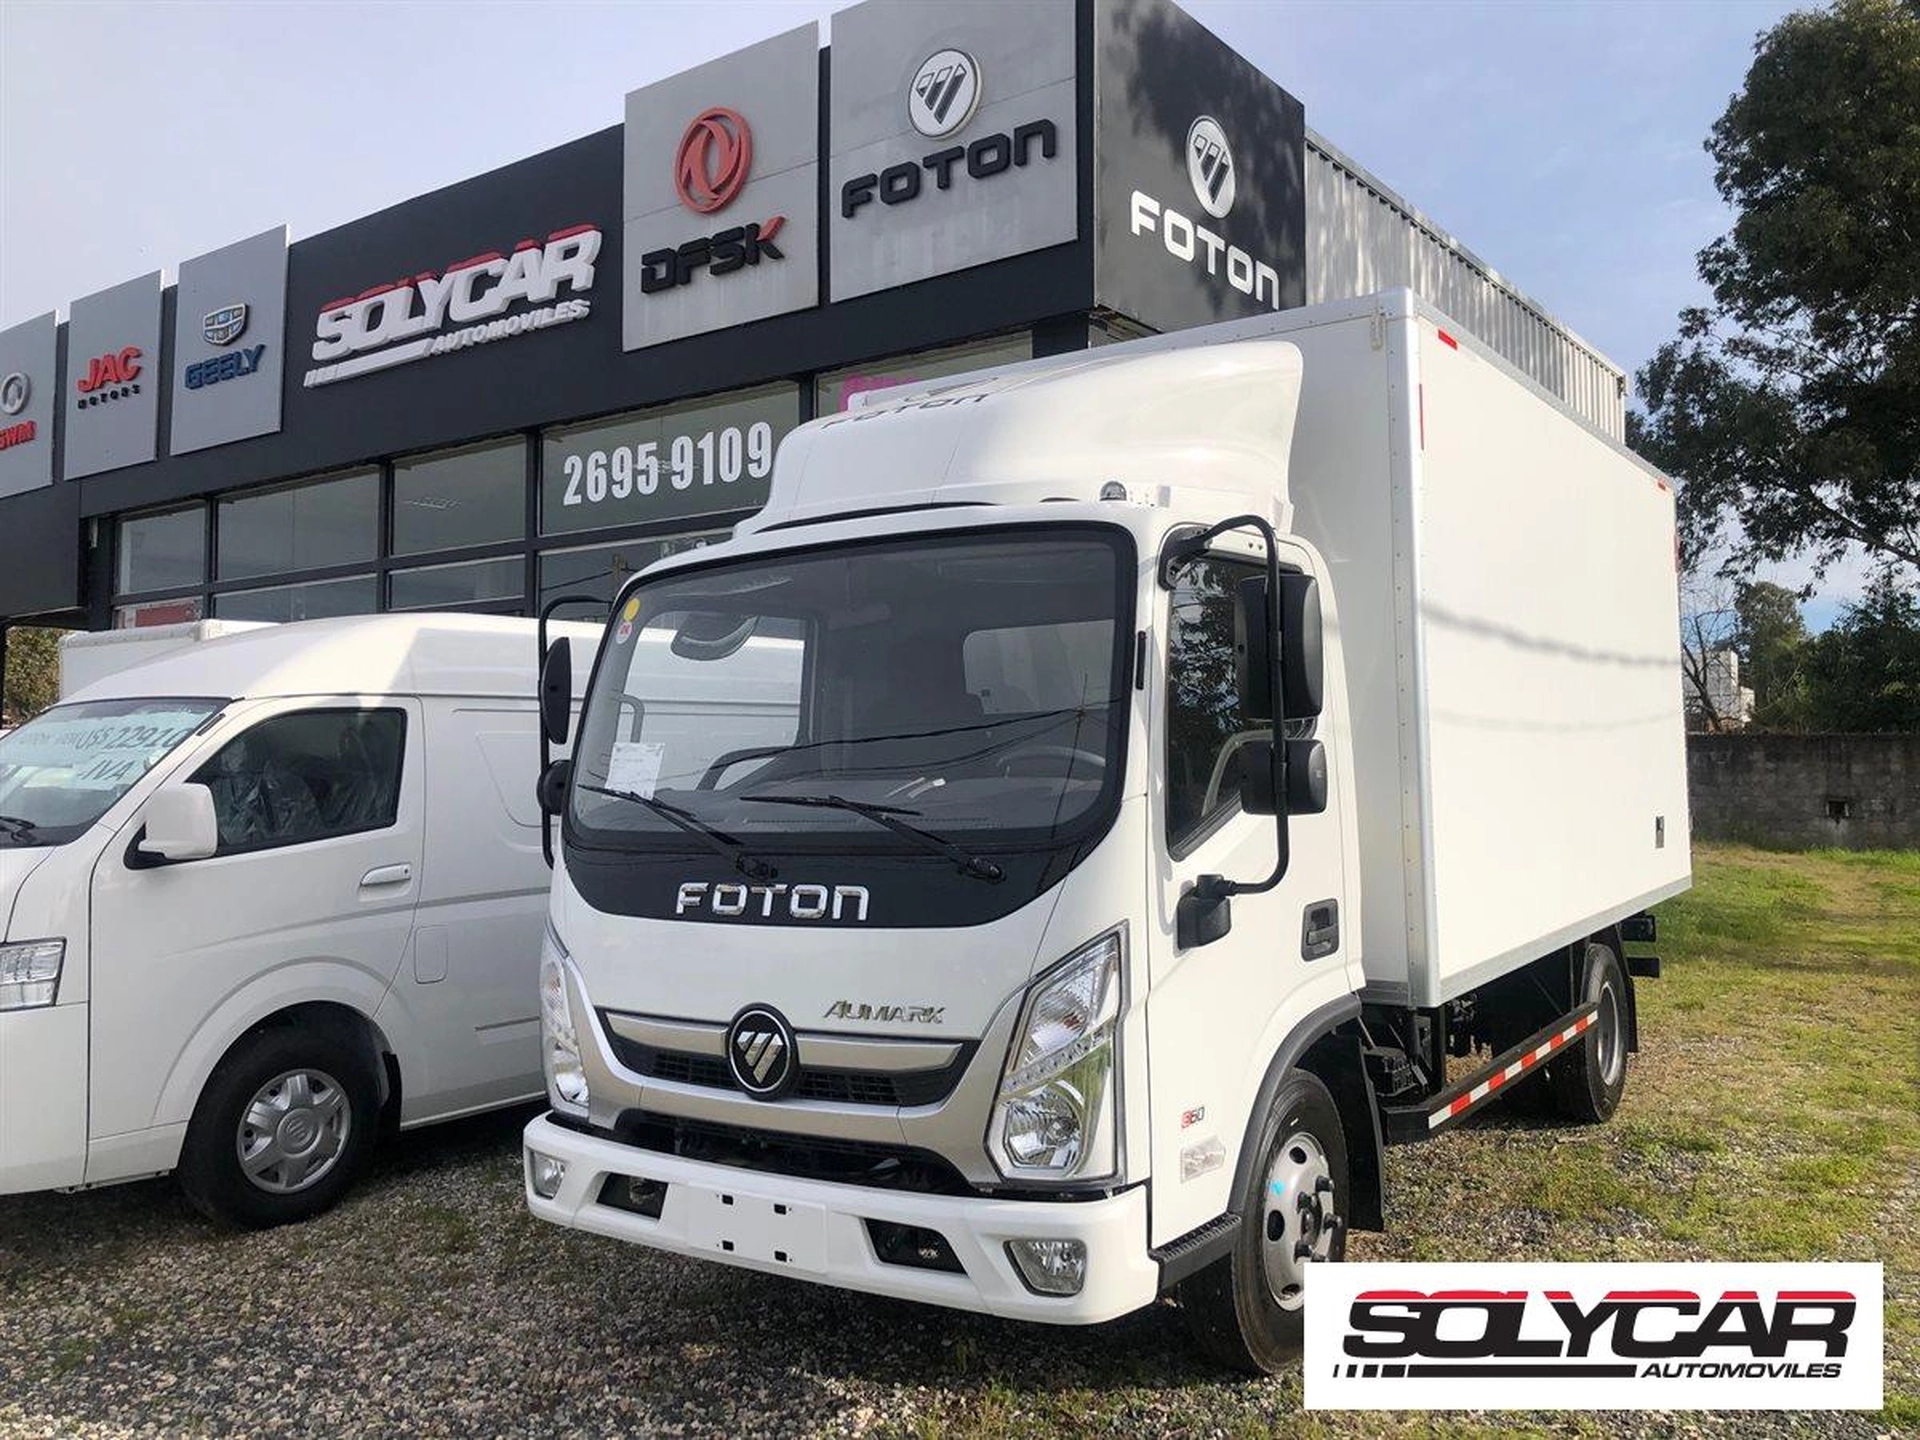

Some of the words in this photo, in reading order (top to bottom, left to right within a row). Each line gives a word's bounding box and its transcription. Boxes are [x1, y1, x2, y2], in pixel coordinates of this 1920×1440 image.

[841, 118, 1057, 219] FOTON
[641, 215, 787, 294] DFSK
[1130, 190, 1280, 311] FOTON
[311, 223, 602, 361] SOLYCAR
[430, 299, 592, 355] AUTOMOVILES
[77, 346, 143, 392] JAC
[184, 344, 267, 390] GEELY
[77, 384, 141, 410] MOTORS
[562, 441, 659, 506] 2695
[671, 422, 772, 490] 9109
[675, 882, 870, 921] FOTON
[822, 999, 946, 1024] AUMARK
